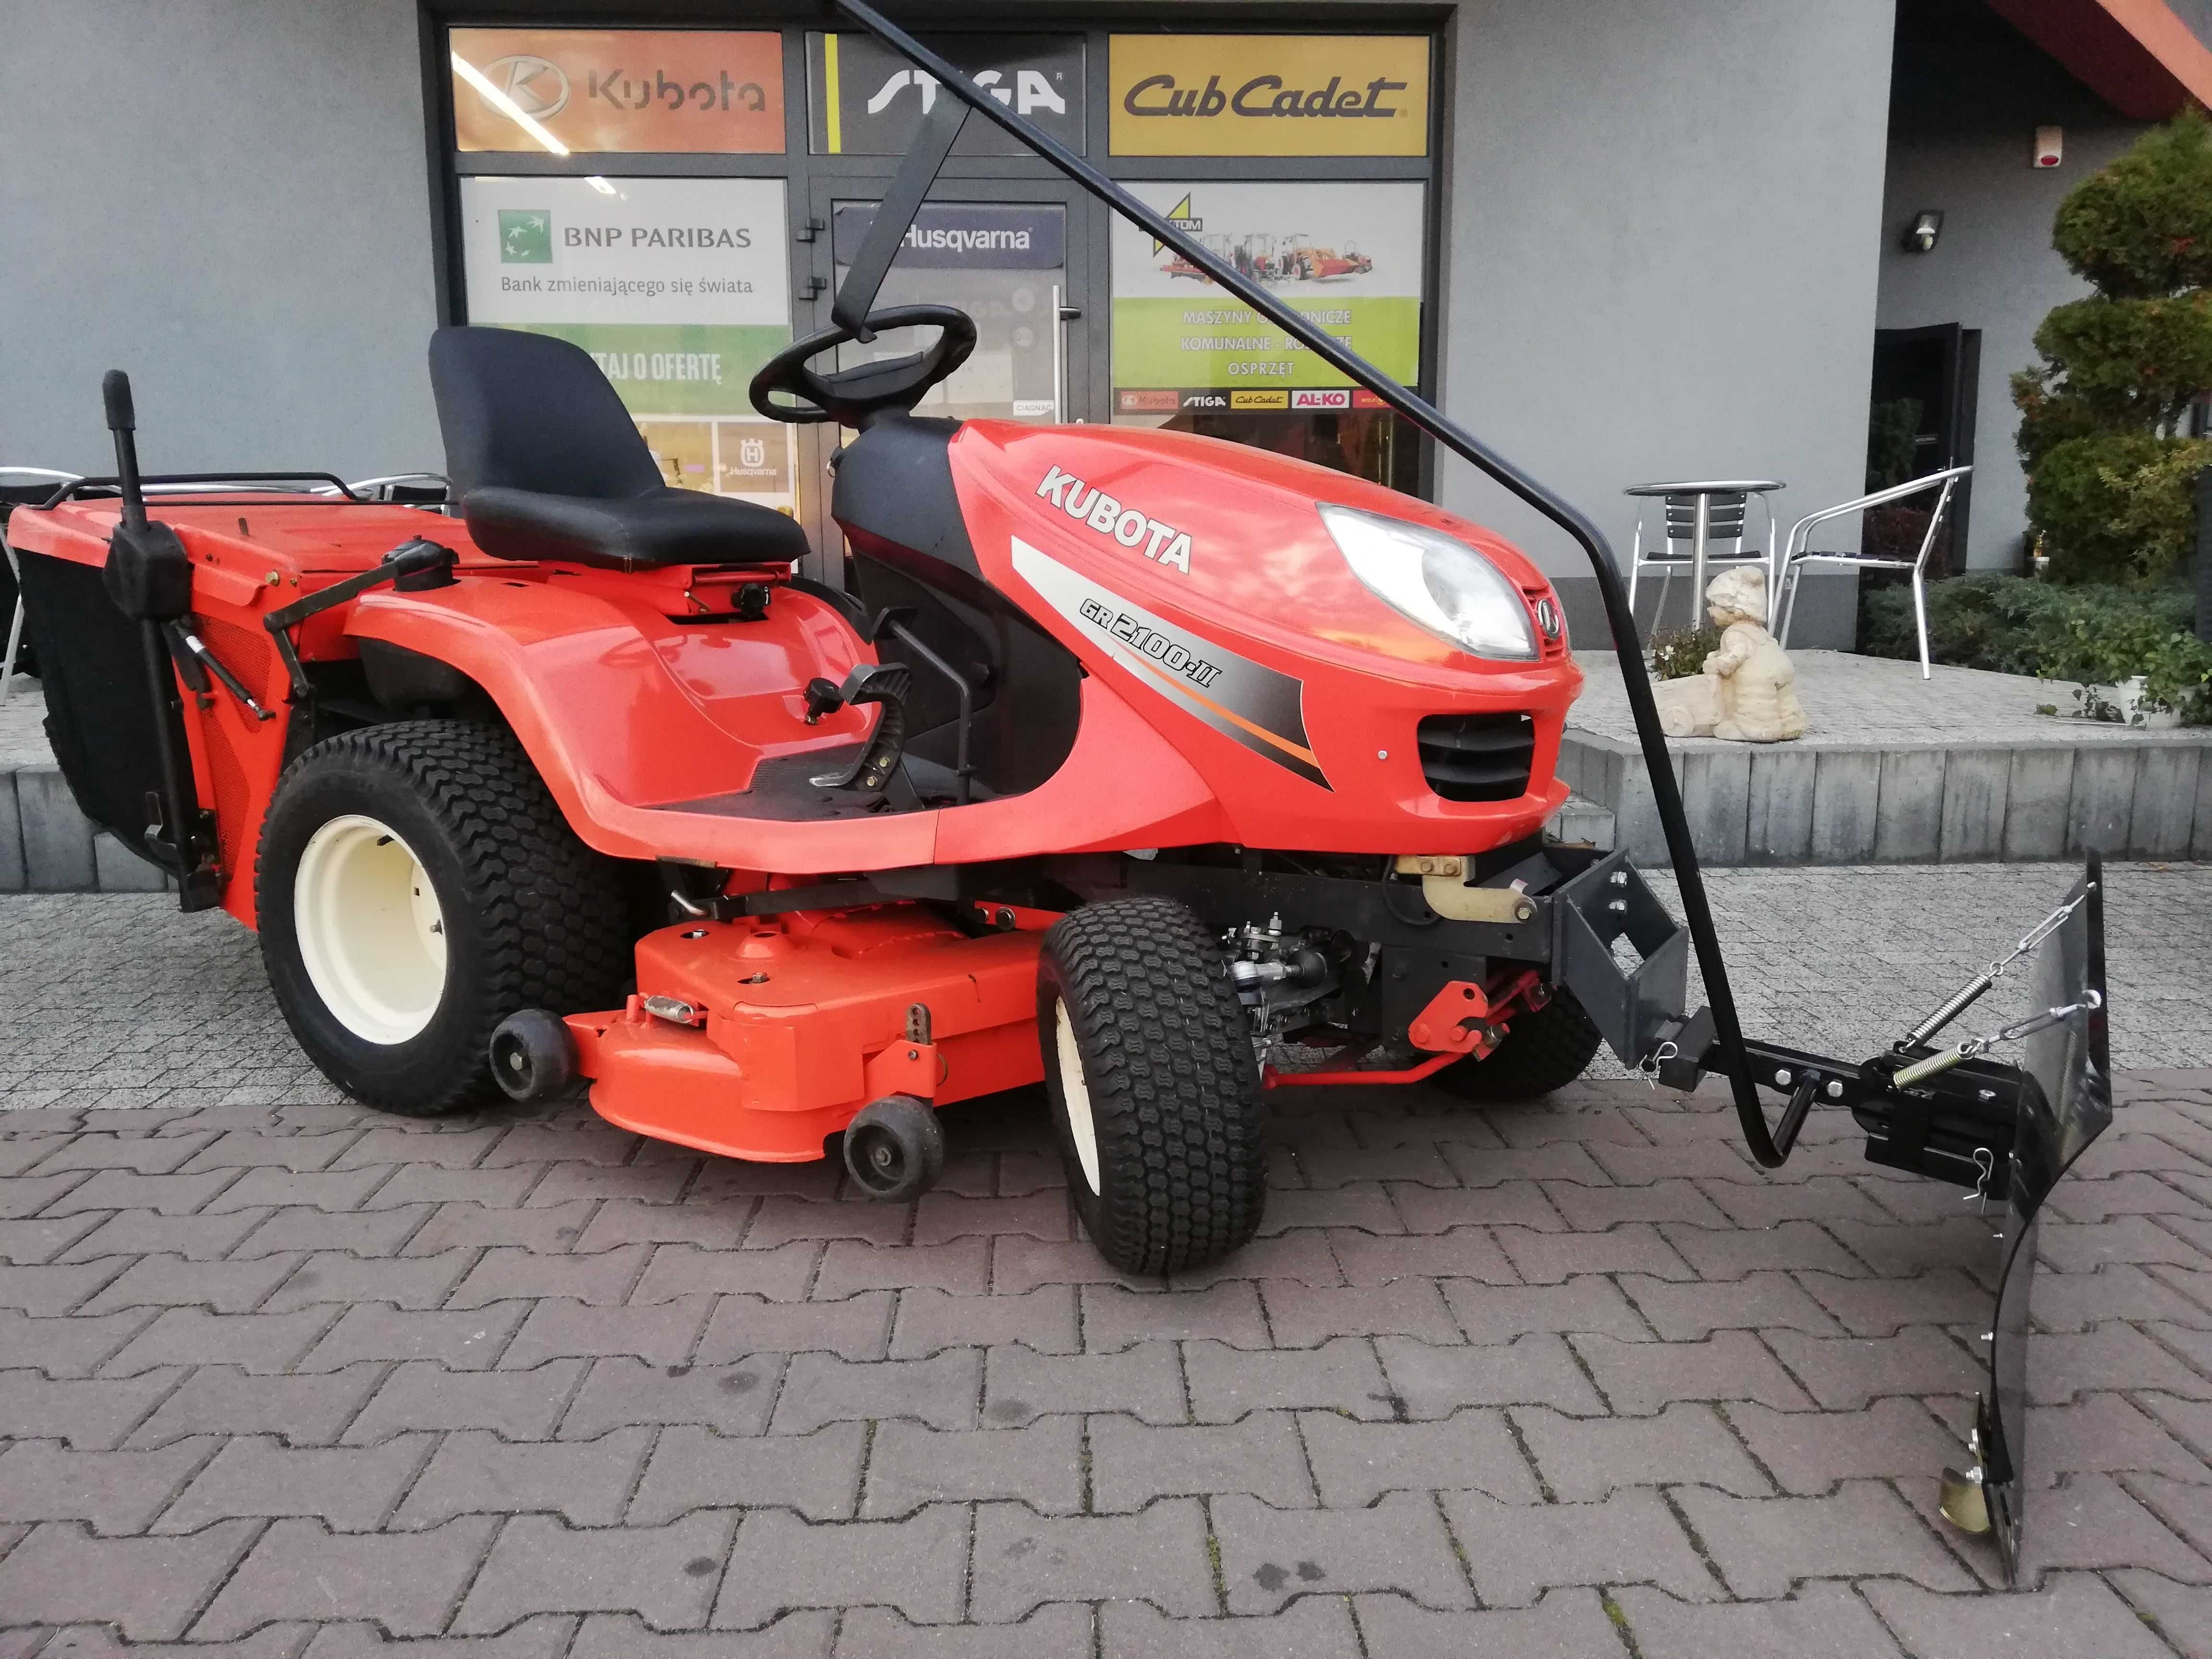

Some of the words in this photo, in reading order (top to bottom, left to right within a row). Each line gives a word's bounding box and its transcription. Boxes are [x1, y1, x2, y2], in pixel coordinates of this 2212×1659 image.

[588, 69, 765, 111] Kubota
[868, 70, 1065, 114] STGA
[1124, 74, 1226, 117] Cub
[1231, 75, 1407, 117] Cadet
[565, 228, 622, 247] BNP
[631, 228, 751, 248] PARIBAS
[900, 224, 1030, 252] Husqvarna
[502, 276, 541, 291] Bank
[548, 277, 664, 297] zmieniającego
[671, 278, 692, 296] się
[699, 278, 753, 293] świata
[1183, 311, 1251, 324] MASZYNY
[1256, 311, 1351, 324] ODNICZE
[1181, 338, 1271, 350] KOMUNALNE
[633, 353, 647, 380] O
[651, 353, 722, 385] OFERTĘ
[1228, 362, 1294, 378] OSPRZĘT
[1183, 397, 1226, 407] STIGA
[1297, 393, 1345, 406] AL-KO
[731, 467, 776, 476] Husqvarna
[1035, 464, 1191, 575] KUBOTA
